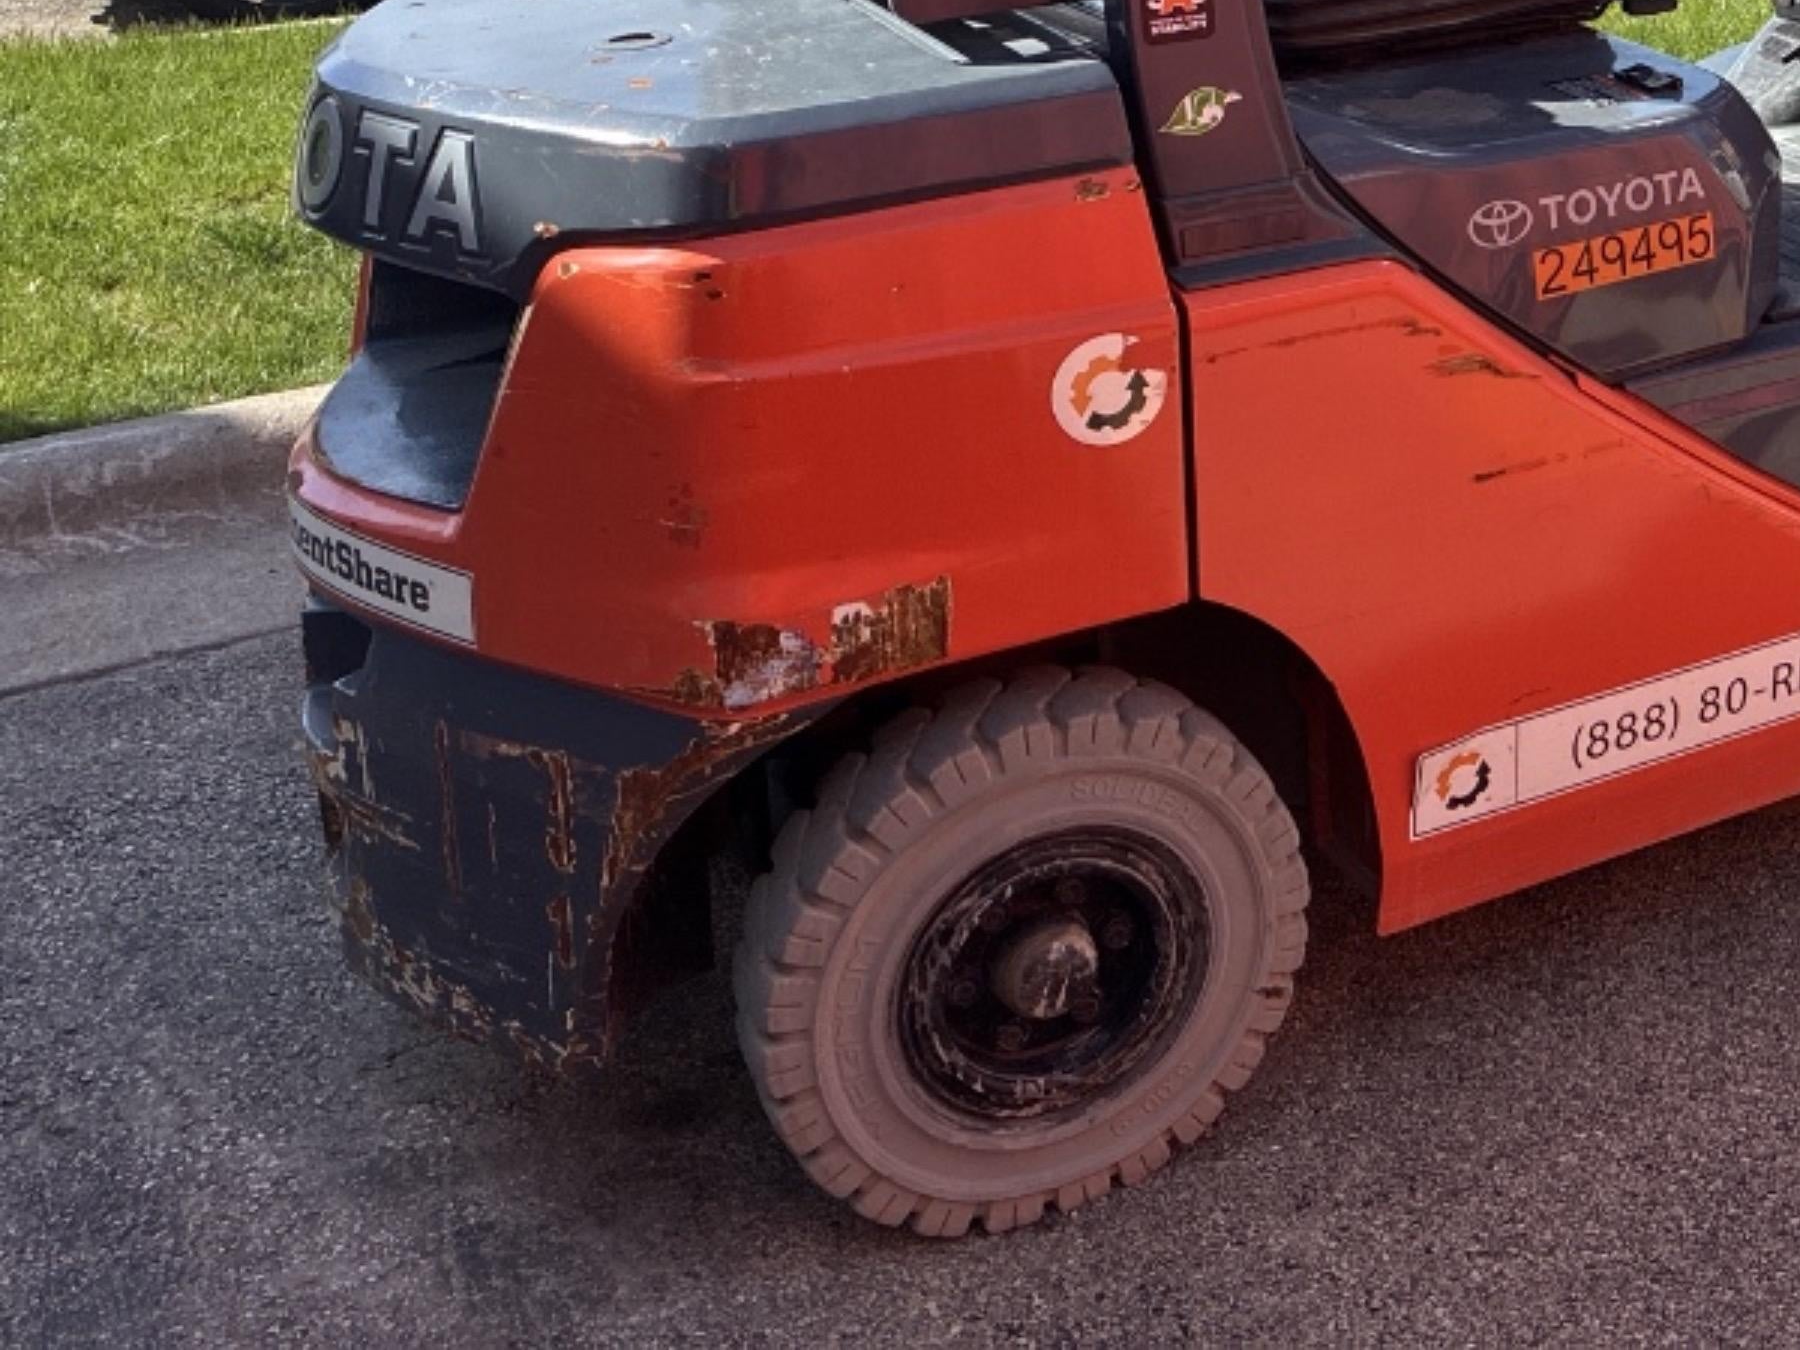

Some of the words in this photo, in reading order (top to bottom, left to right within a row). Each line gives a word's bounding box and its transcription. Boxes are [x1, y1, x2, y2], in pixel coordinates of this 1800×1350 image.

[1538, 167, 1705, 230] TOYOTA
[1538, 215, 1712, 295] 249495
[1572, 696, 1679, 769] (888)
